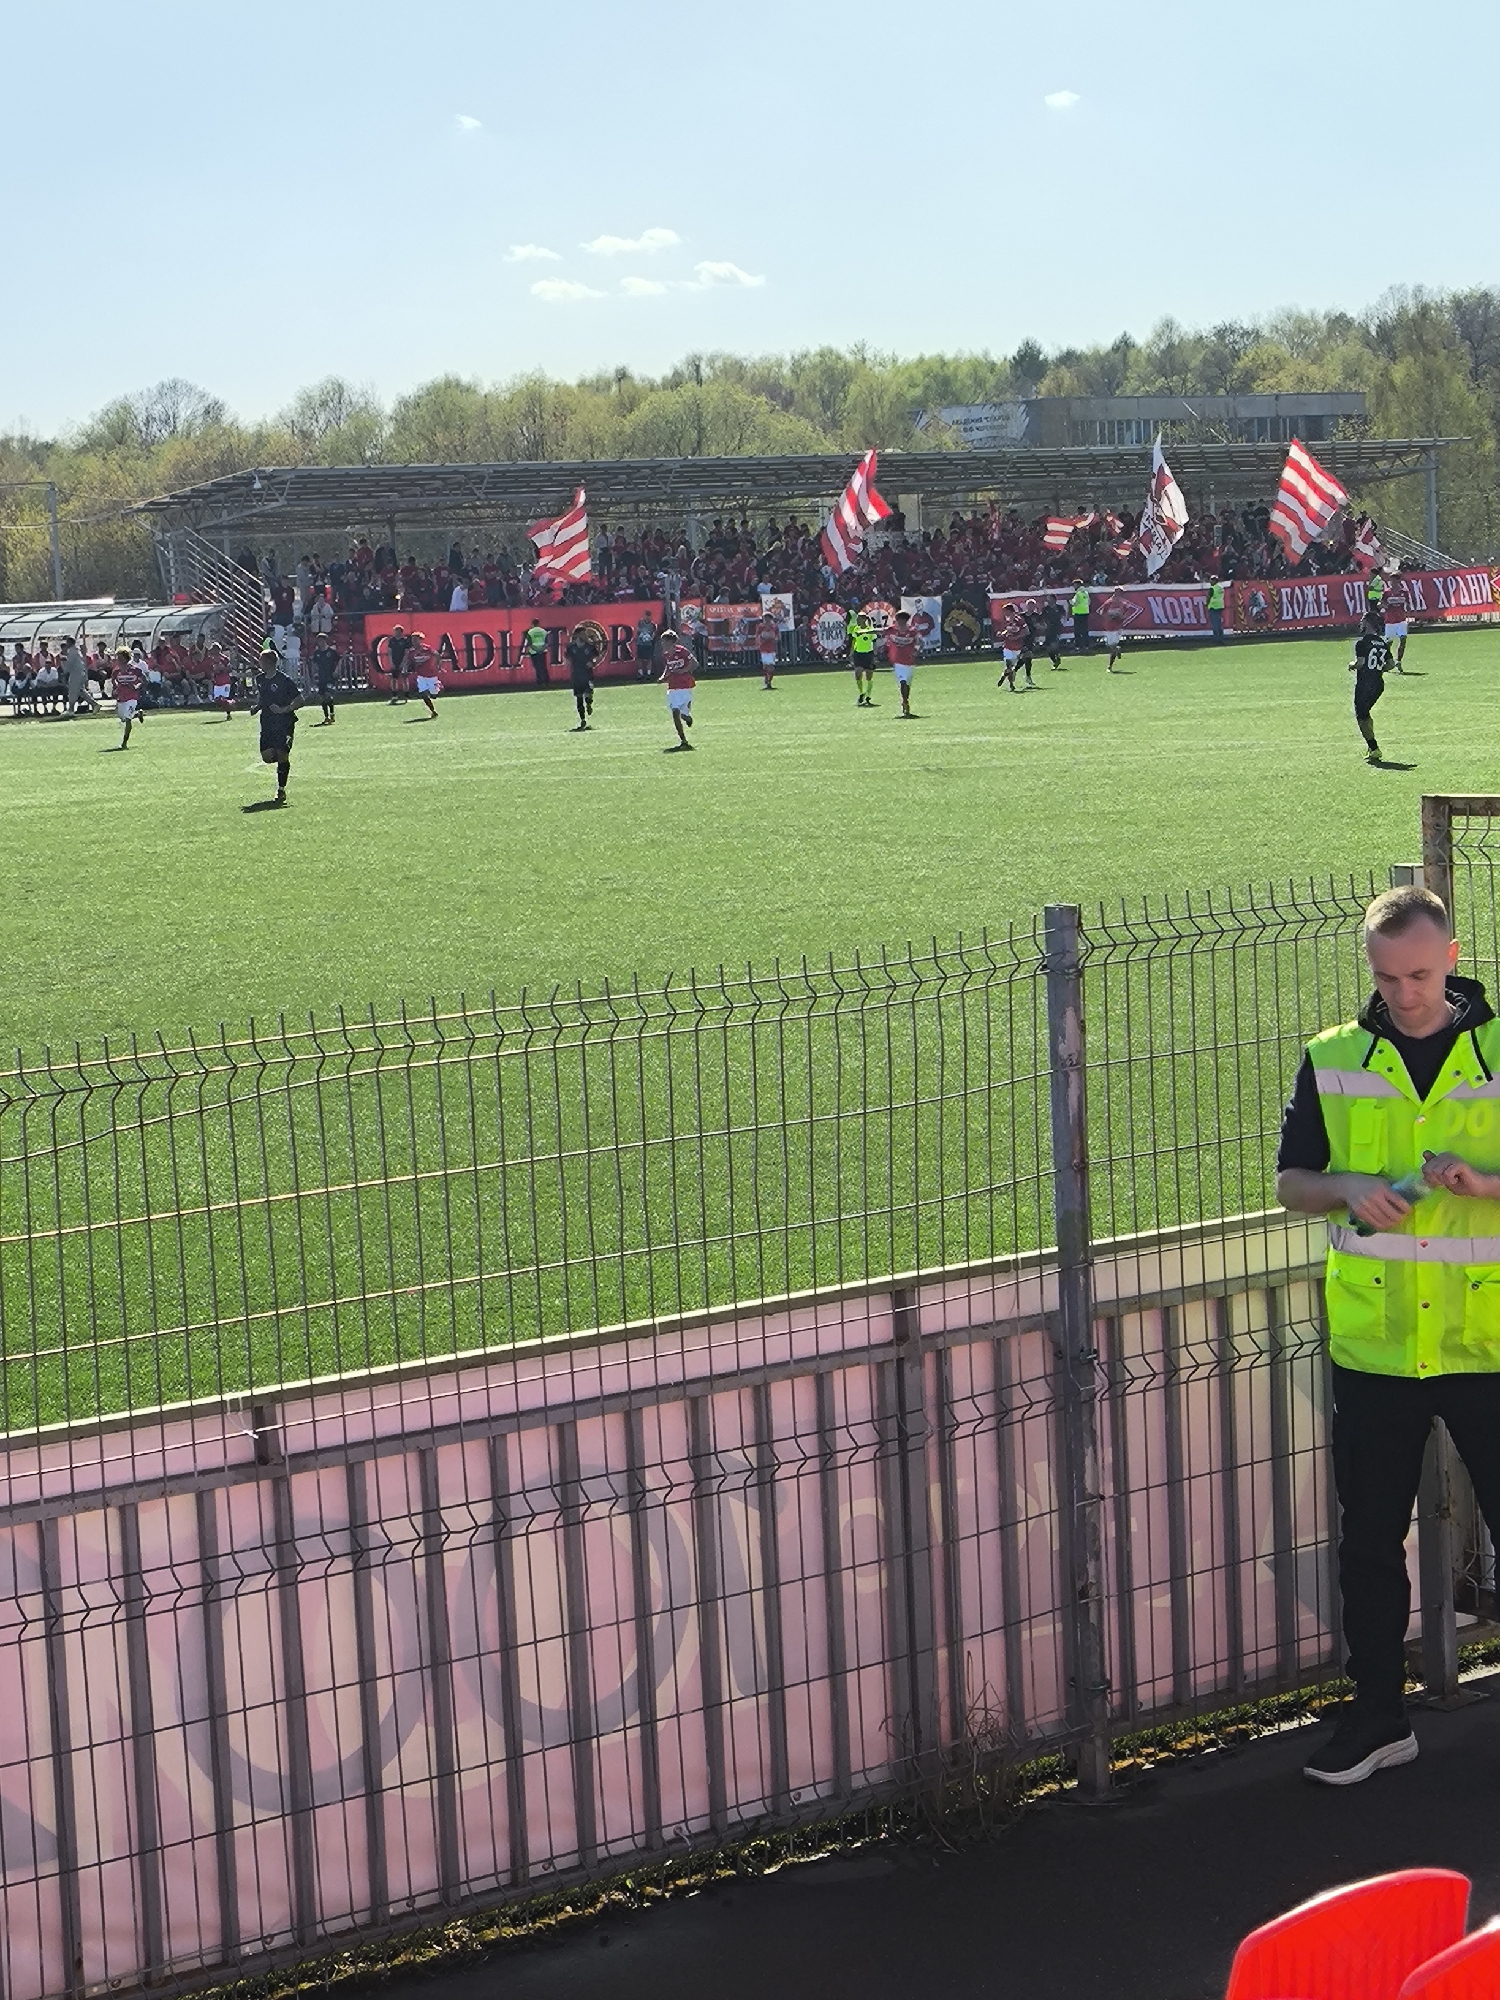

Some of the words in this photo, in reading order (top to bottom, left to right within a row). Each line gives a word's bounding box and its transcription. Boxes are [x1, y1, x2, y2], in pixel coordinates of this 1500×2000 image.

[1280, 583, 1336, 620] БОЖЕ,
[1343, 578, 1428, 617] СПАК
[1432, 572, 1493, 609] ХРАНИ
[1148, 595, 1222, 626] NORT
[821, 630, 844, 640] FIRM
[1367, 647, 1388, 671] 63
